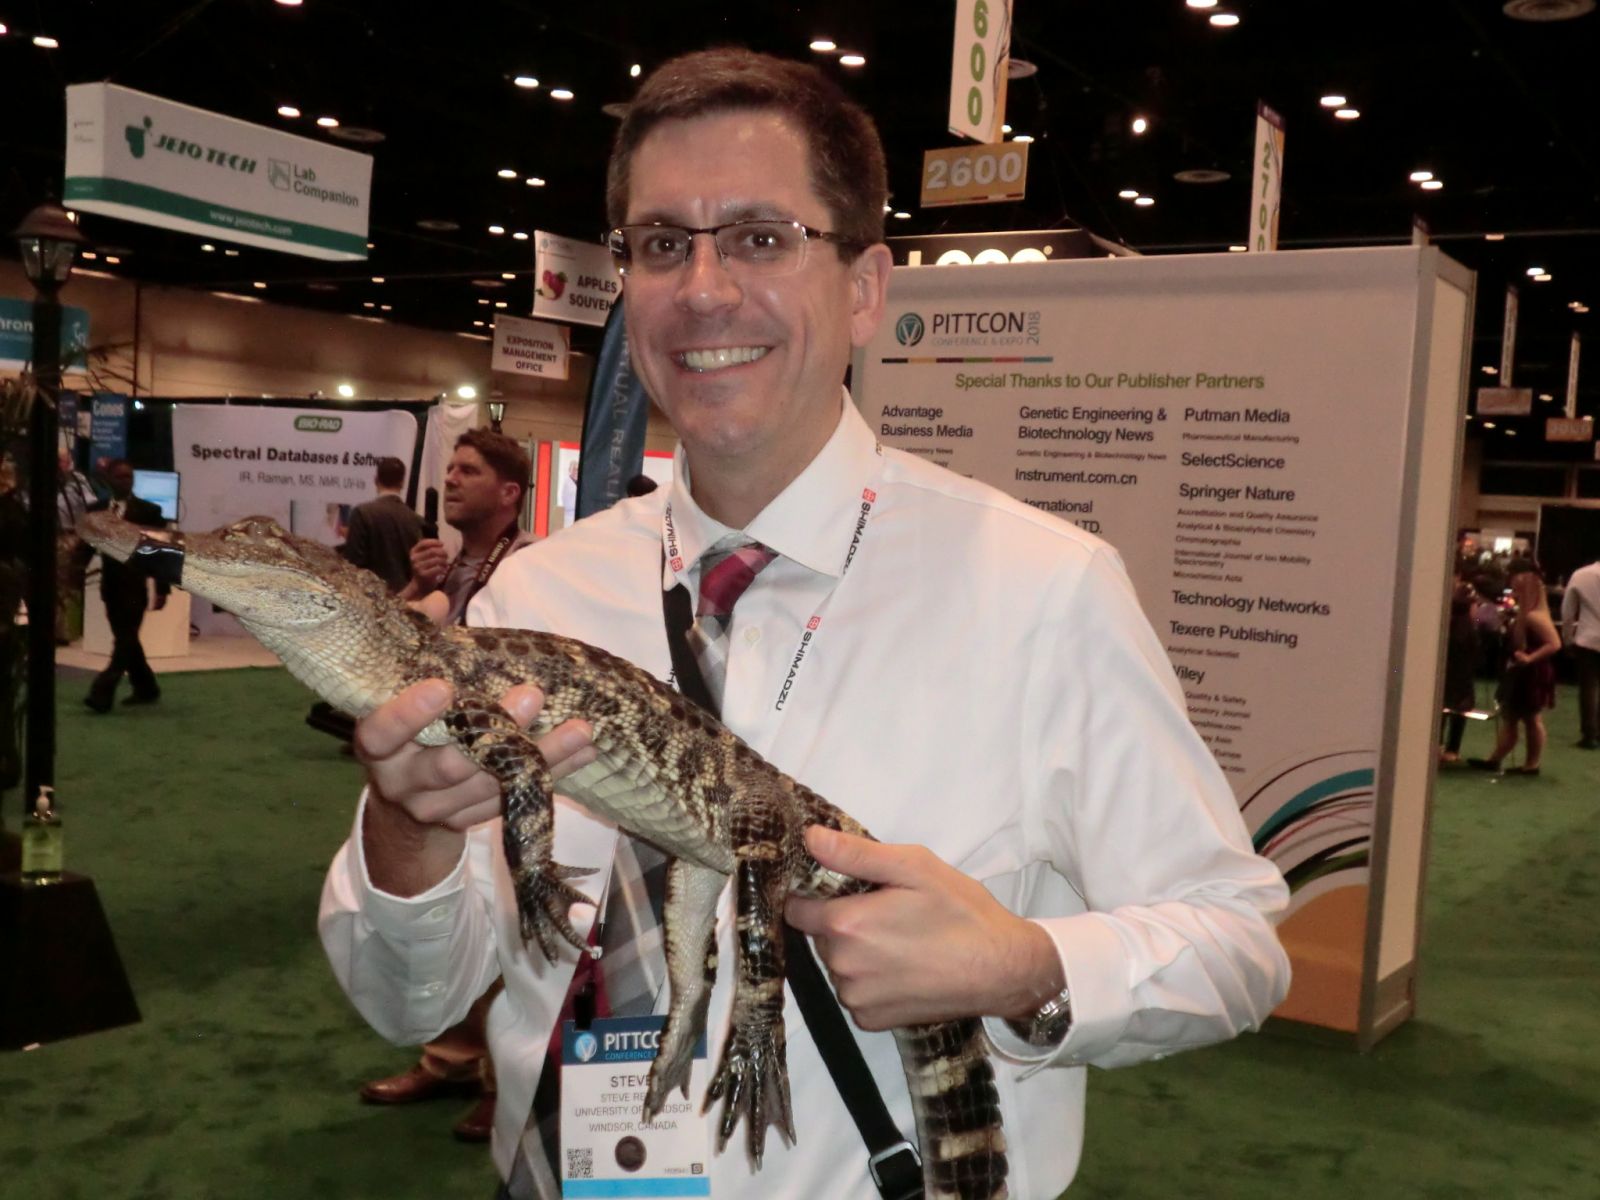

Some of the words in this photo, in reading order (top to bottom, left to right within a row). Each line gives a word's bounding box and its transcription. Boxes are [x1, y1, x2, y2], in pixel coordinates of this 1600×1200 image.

[206, 147, 257, 174] TECH
[293, 163, 317, 183] Lab
[926, 152, 1022, 190] 2600
[293, 180, 360, 207] Companion
[576, 275, 618, 294] APPLES
[931, 311, 1025, 334] PITTCON
[1027, 310, 1041, 345] 2018
[506, 335, 555, 351] EXPOSITION
[502, 346, 558, 363] MANAGEMENT
[515, 360, 544, 373] OFFICE
[955, 372, 1007, 391] Special
[1010, 373, 1062, 389] Thanks
[1065, 375, 1081, 389] to
[1084, 373, 1114, 389] Our
[1116, 372, 1191, 389] Publisher
[1195, 373, 1265, 390] Partners
[881, 405, 944, 421] Advantage
[1019, 405, 1069, 420] Genetic
[1072, 406, 1154, 424] Engineering
[1156, 407, 1168, 421] &
[1184, 407, 1241, 423] Putman
[1244, 409, 1291, 424] Media
[880, 423, 934, 438] Business
[936, 425, 974, 438] Media
[1018, 425, 1113, 444] Biotechnology
[1115, 427, 1154, 442] News
[191, 443, 261, 461] Spectral
[267, 446, 339, 465] Databases
[342, 450, 350, 465] &
[1016, 449, 1042, 458] Genetic
[1043, 450, 1085, 461] Engineering
[1094, 451, 1146, 462] Biotechnology
[1147, 453, 1168, 461] News
[1180, 451, 1286, 469] SelectScience
[1014, 467, 1138, 486] Instrument.com.cn
[1179, 482, 1242, 502] Springer
[1244, 485, 1296, 502] Nature
[1020, 498, 1094, 514] ternational
[1177, 507, 1227, 519] Accreditation
[1229, 510, 1244, 520] and
[1245, 510, 1274, 521] Quality
[1275, 512, 1319, 523] Assurance
[1075, 520, 1104, 535] TD.
[1176, 521, 1214, 533] Analytical
[1274, 526, 1317, 539] Chemistry
[1174, 549, 1222, 560] International
[1222, 552, 1253, 562] Journal
[1254, 553, 1263, 562] of
[1279, 555, 1312, 566] Mobility
[1171, 590, 1254, 613] Technology
[1257, 596, 1331, 616] Networks
[1169, 620, 1216, 639] Texere
[1218, 624, 1299, 648] Publishing
[775, 630, 813, 712] SHIMADZU
[610, 1074, 651, 1088] STEVE
[600, 1092, 632, 1103] STEVE
[574, 1106, 628, 1118] UNIVERSITY
[588, 1121, 636, 1133] WINDSOR,
[636, 1120, 679, 1131] CANADA
